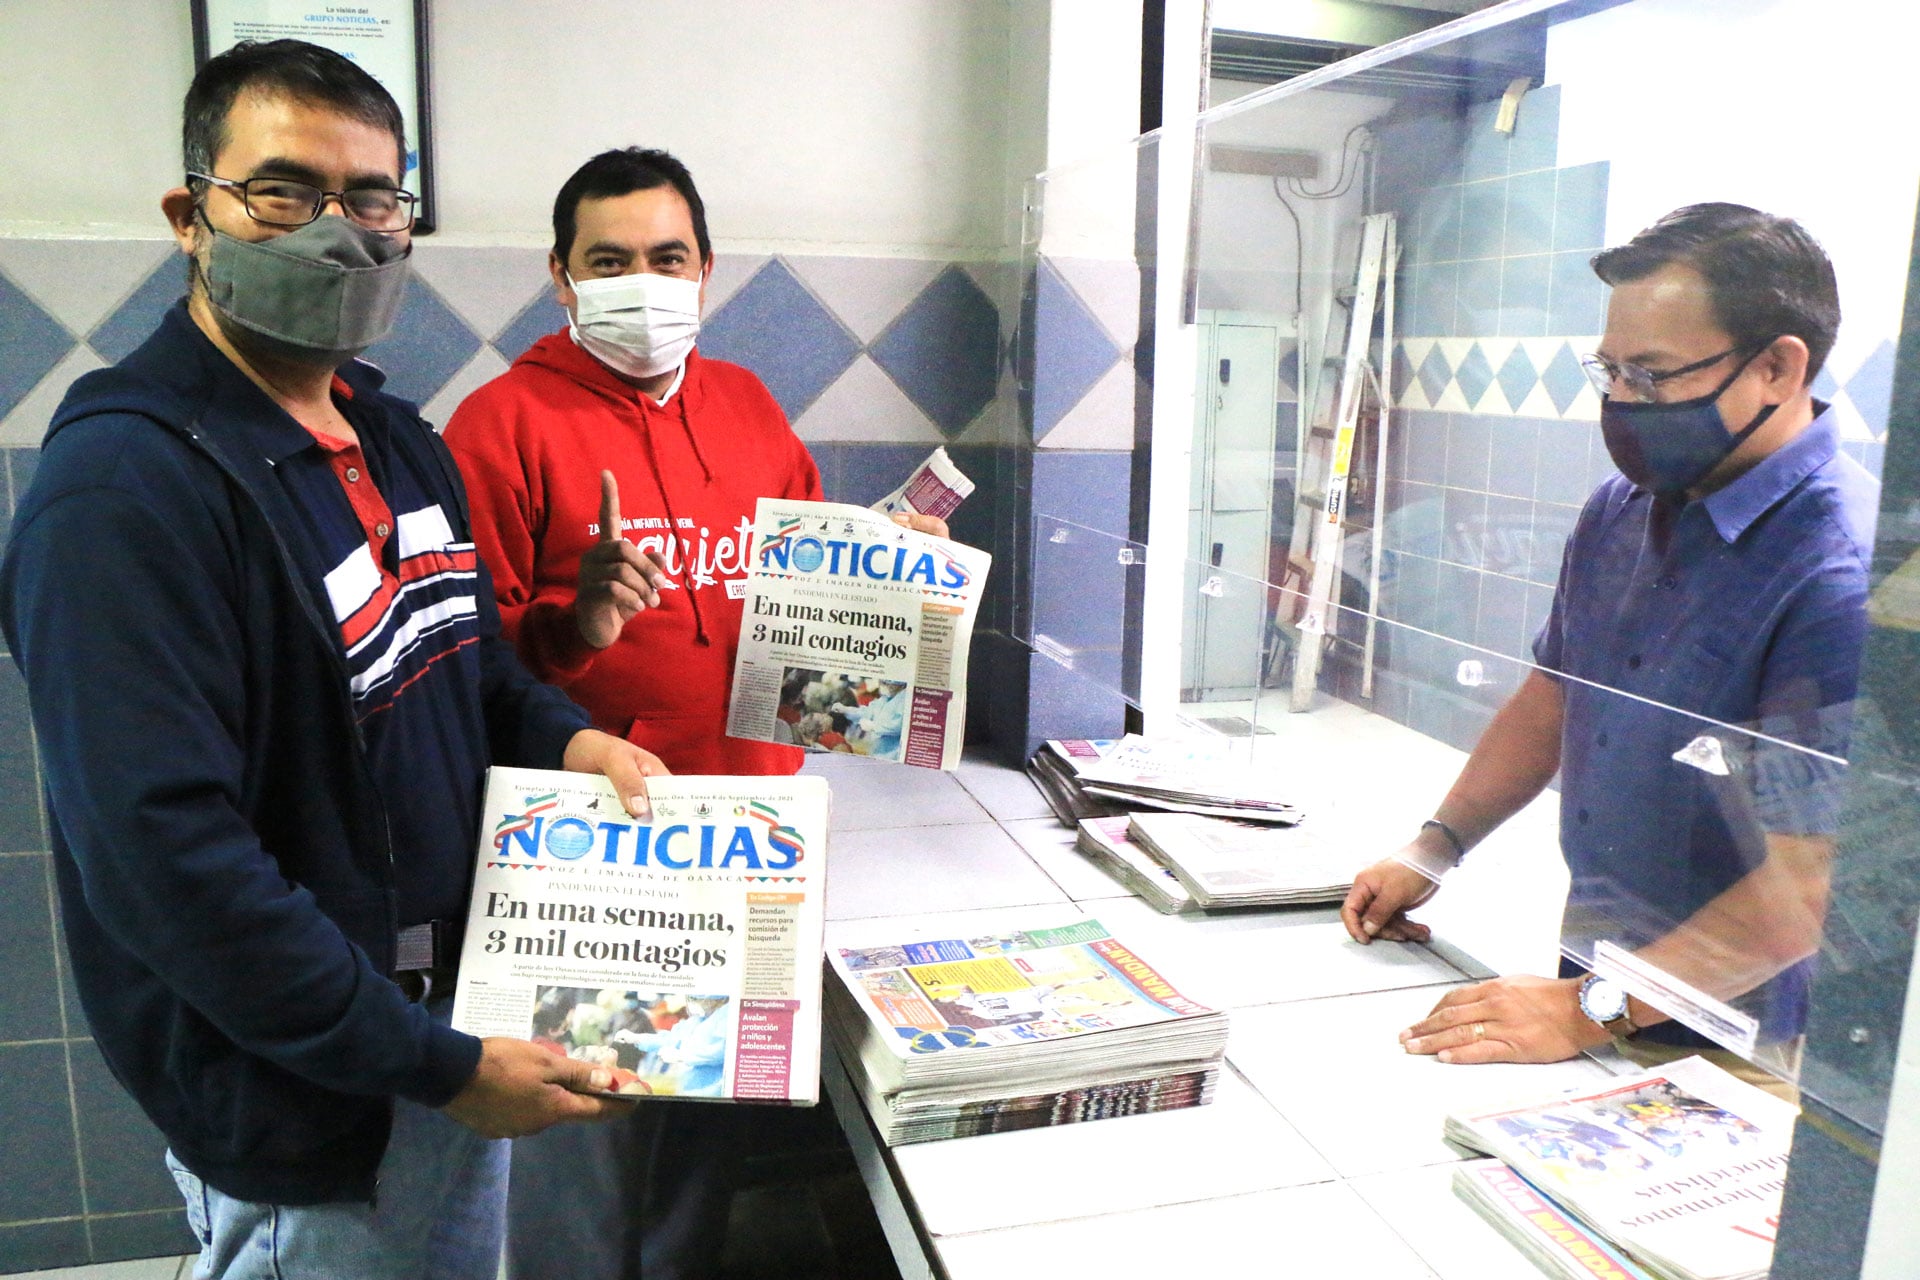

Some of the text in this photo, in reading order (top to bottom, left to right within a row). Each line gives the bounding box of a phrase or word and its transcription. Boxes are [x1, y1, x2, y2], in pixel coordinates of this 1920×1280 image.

[304, 14, 334, 22] GRUPO
[632, 517, 664, 529] INFANTIL
[761, 534, 967, 589] NOTICIAS
[826, 579, 862, 588] IMAGEN
[883, 585, 921, 594] OAXACA
[754, 594, 913, 637] En una semana,
[752, 623, 767, 642] 3
[770, 625, 805, 647] mil
[808, 634, 907, 662] contagios
[497, 813, 803, 871] NOTICIAS
[549, 865, 576, 875] VOZ
[598, 868, 655, 881] IMAGEN
[687, 874, 743, 883] OAXACA
[485, 891, 734, 937] En una semana,
[749, 906, 786, 915] Demandan
[748, 924, 779, 933] comisión
[747, 934, 781, 942] búsqueda
[484, 928, 508, 954] 3
[513, 928, 567, 958] mil
[573, 937, 727, 974] contagios
[742, 1013, 768, 1022] Avalan
[741, 1023, 779, 1032] protección
[746, 1032, 767, 1041] niños
[767, 1034, 773, 1042] y
[740, 1041, 787, 1051] adolescentes
[1619, 1187, 1766, 1228] hermanos
